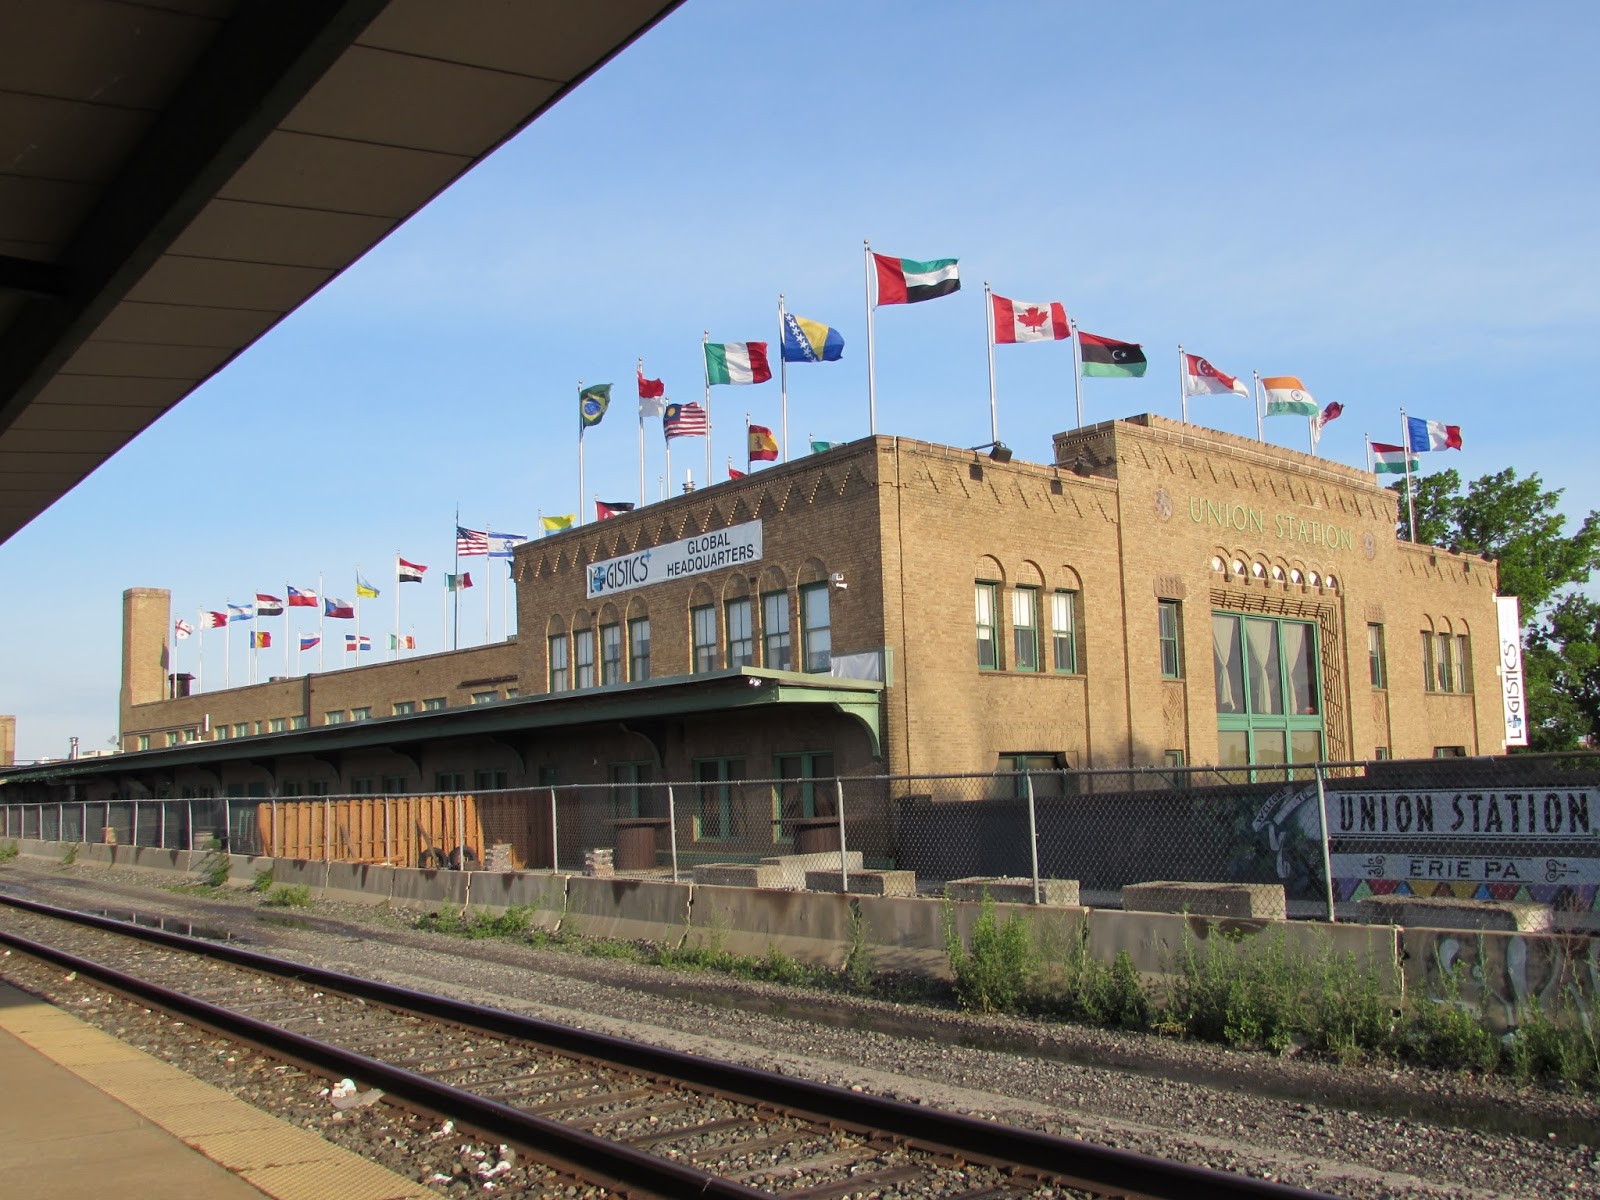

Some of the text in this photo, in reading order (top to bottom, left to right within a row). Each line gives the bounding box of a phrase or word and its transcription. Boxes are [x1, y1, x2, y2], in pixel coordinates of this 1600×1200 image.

[1189, 496, 1352, 551] UNION STATION
[687, 532, 730, 555] GLOBAL
[667, 544, 754, 577] HEADQUARTERS
[1256, 788, 1287, 823] WELCOME
[1296, 790, 1308, 801] TO
[1340, 793, 1589, 833] UNION STATION
[1484, 860, 1521, 879] PA
